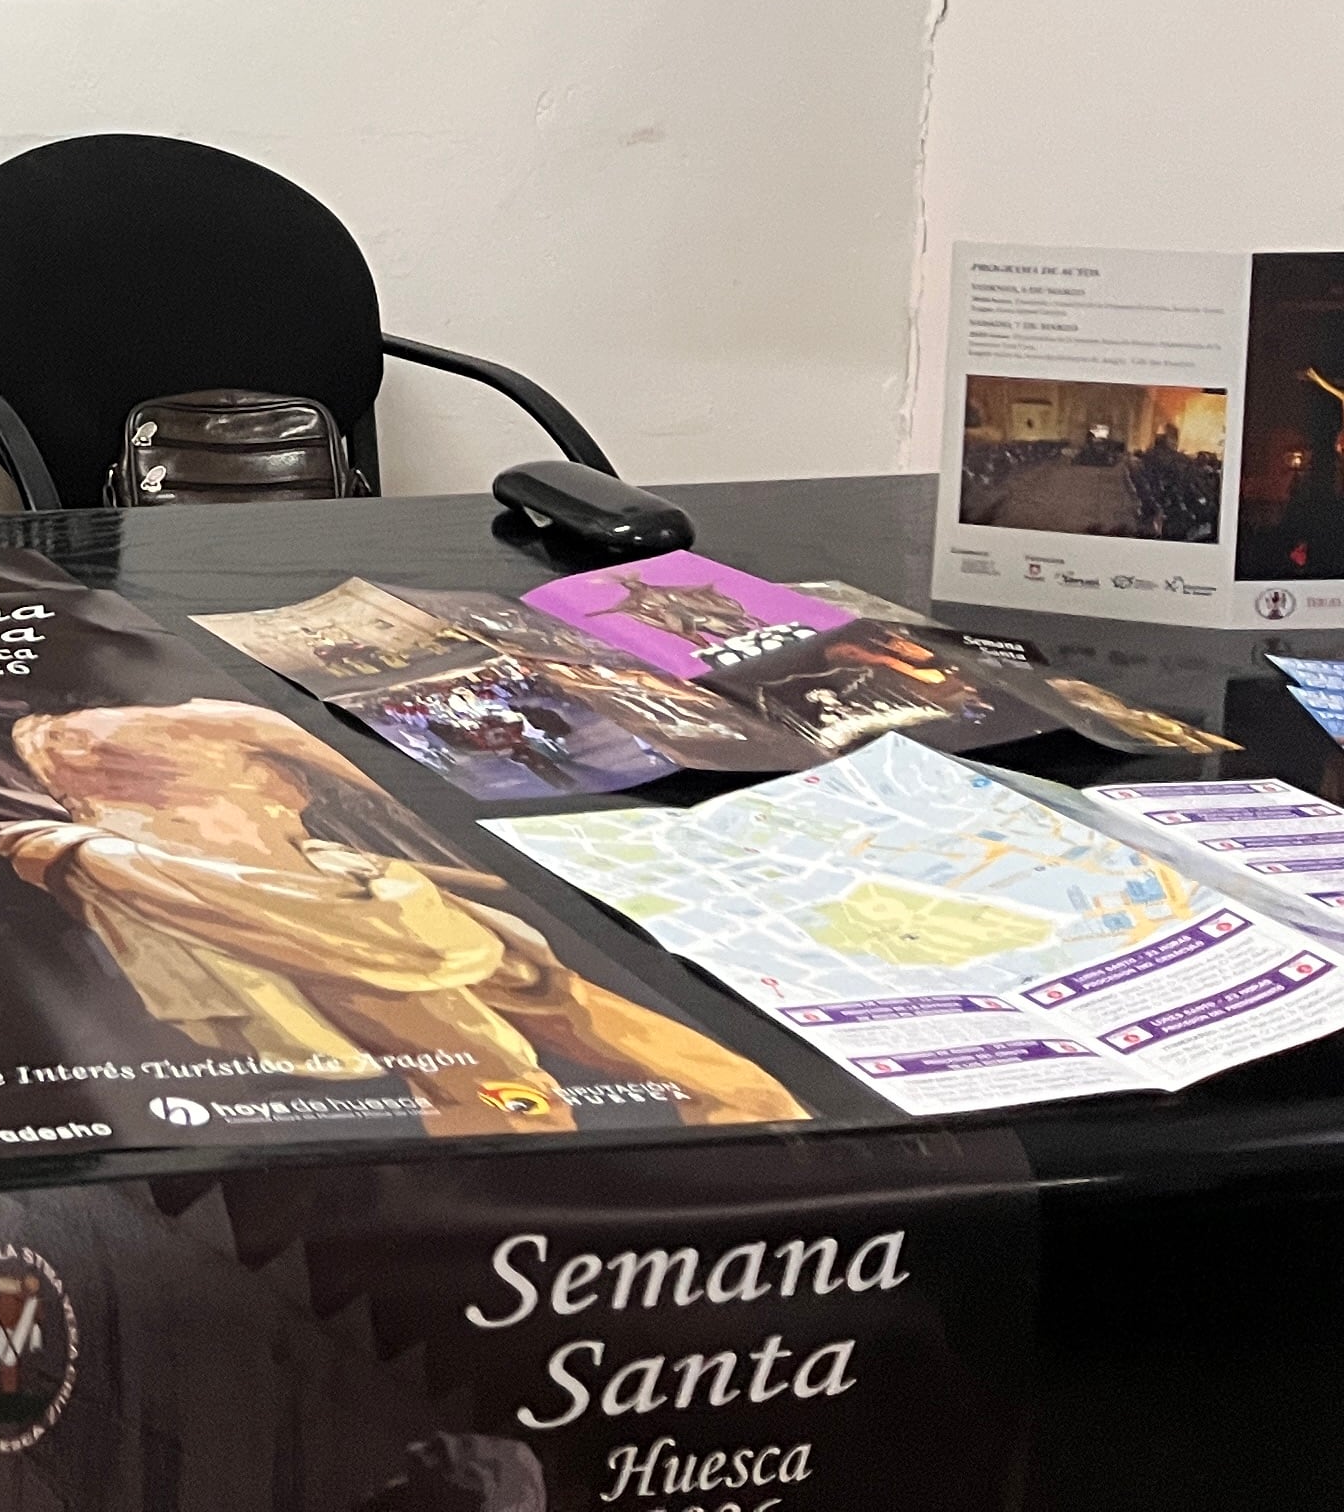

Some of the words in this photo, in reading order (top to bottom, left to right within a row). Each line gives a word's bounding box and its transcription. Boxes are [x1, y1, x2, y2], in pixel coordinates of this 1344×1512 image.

[16, 1061, 135, 1086] Interés
[141, 1054, 295, 1080] Turístico
[349, 1047, 480, 1075] Aragón
[0, 1121, 113, 1144] adesho
[465, 1230, 910, 1329] Semana
[516, 1334, 858, 1430] Santa
[600, 1436, 814, 1503] Huesca
